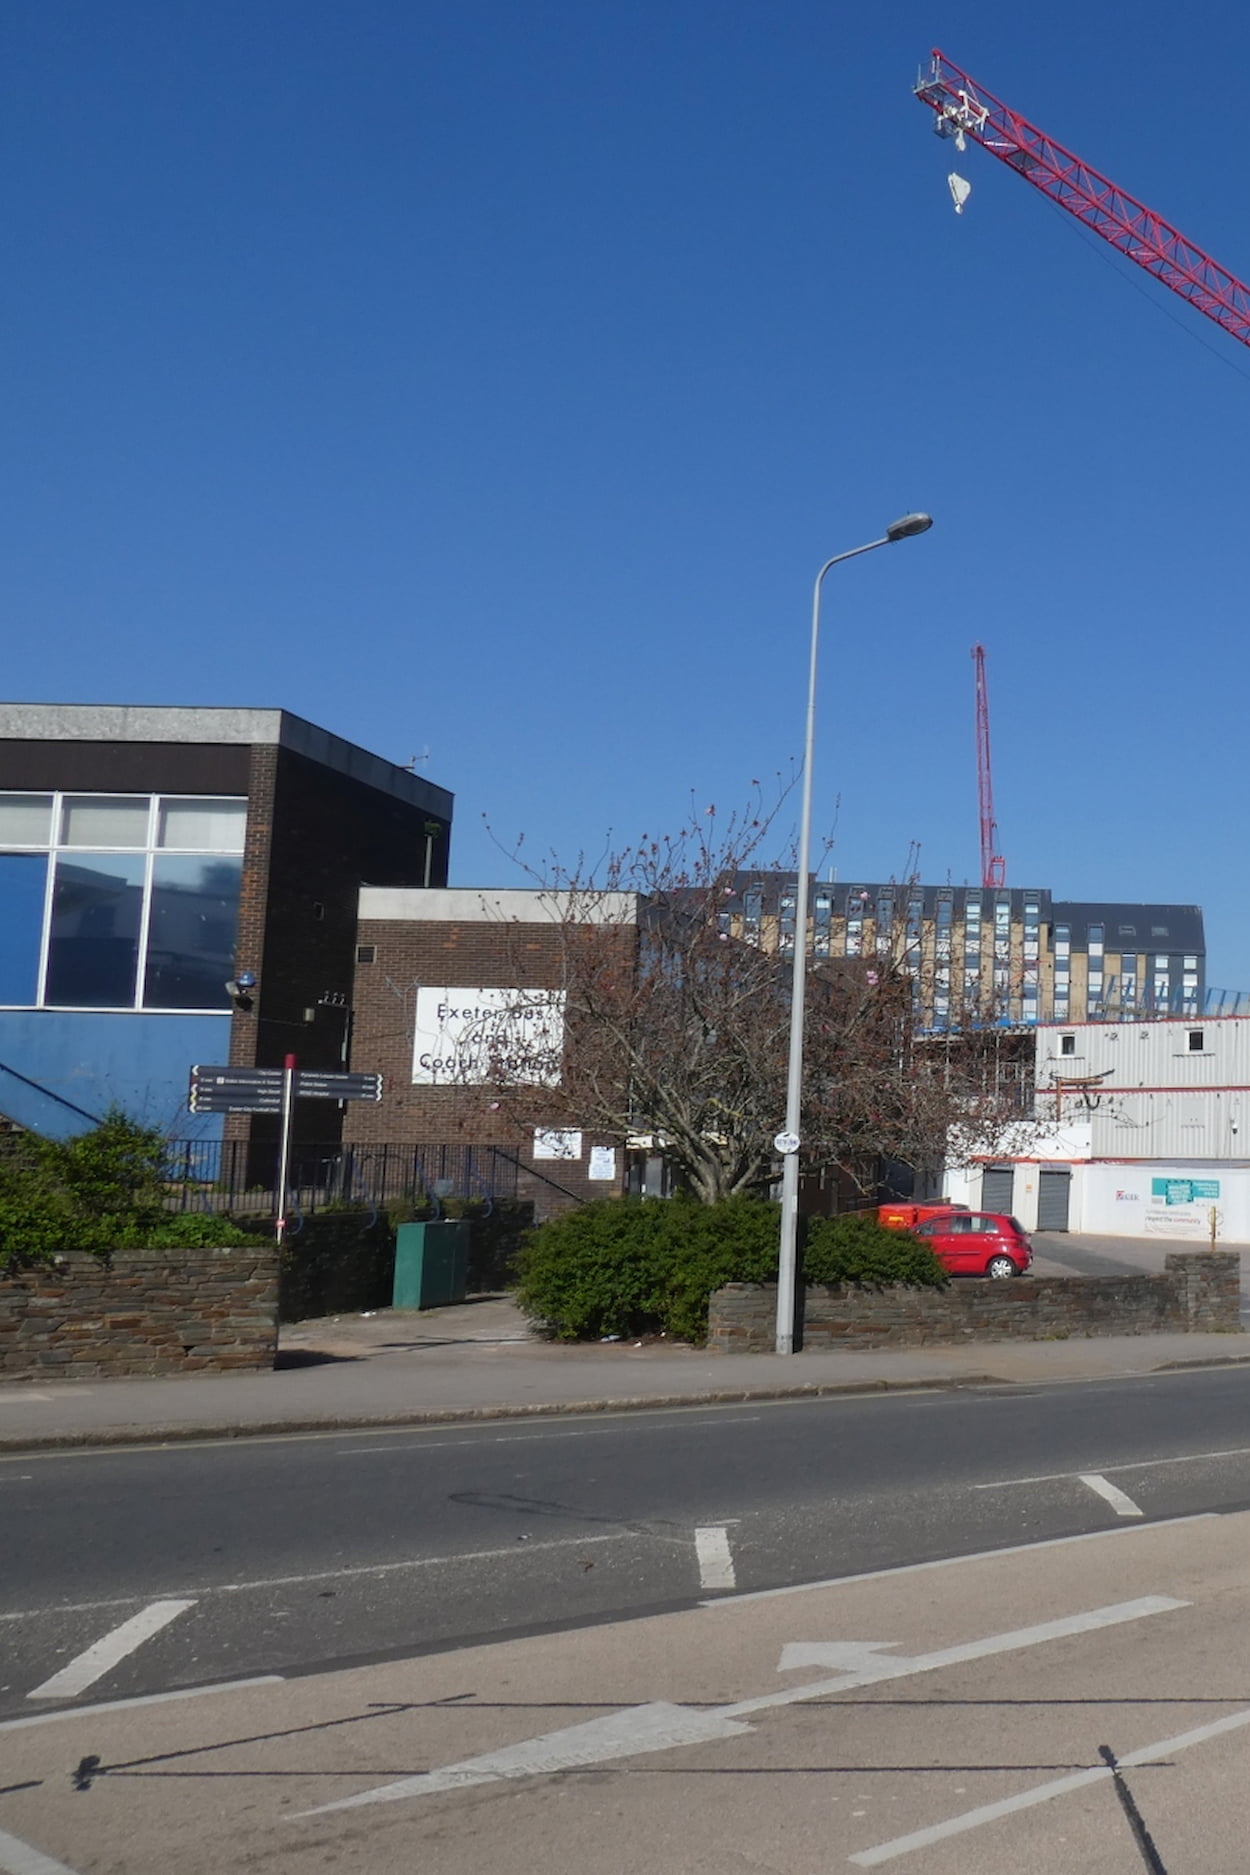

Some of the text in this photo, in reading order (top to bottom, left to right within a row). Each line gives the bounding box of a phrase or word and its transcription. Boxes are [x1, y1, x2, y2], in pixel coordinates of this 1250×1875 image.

[437, 1003, 503, 1021] Exeter
[471, 1027, 507, 1045] and
[419, 1052, 556, 1072] Coach tation
